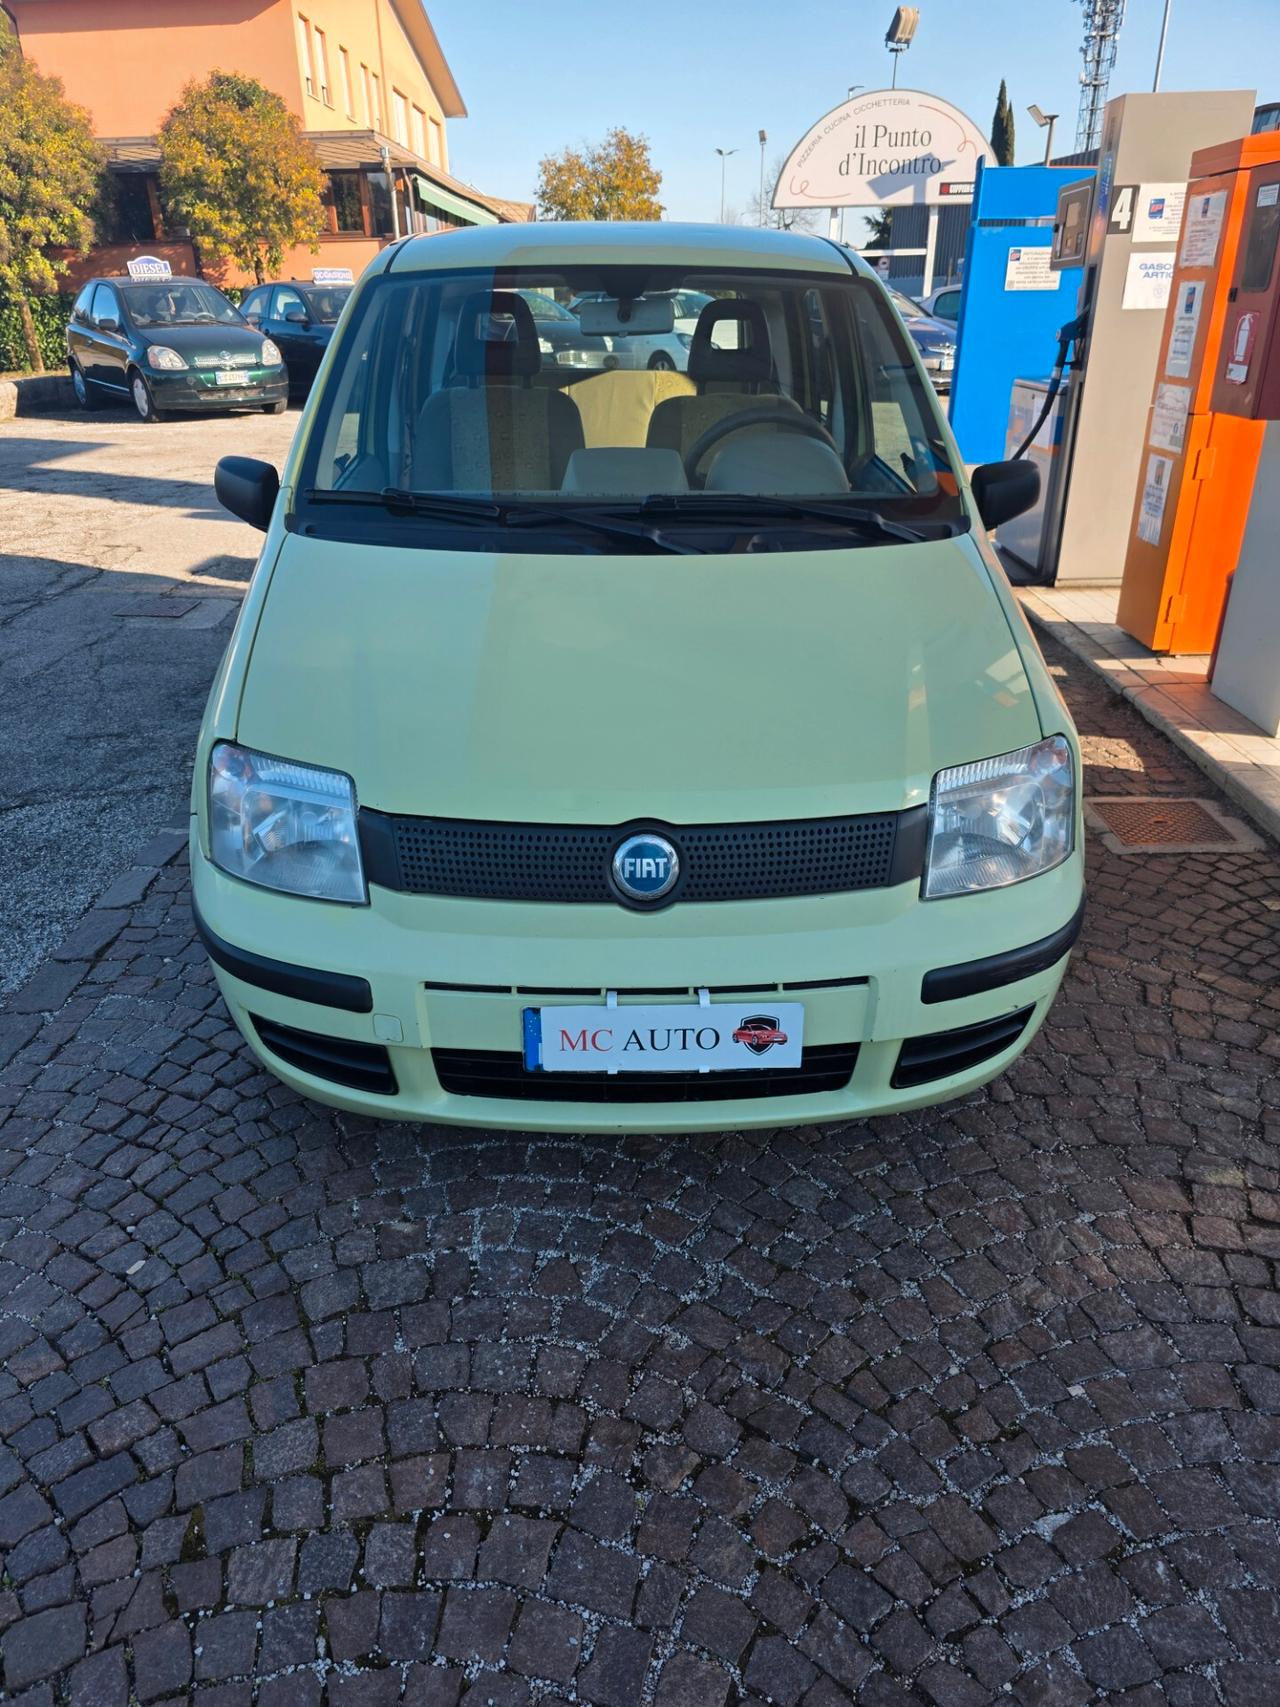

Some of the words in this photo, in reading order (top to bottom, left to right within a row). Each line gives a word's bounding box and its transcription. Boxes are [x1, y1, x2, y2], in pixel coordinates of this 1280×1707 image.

[796, 135, 823, 168] PIZZERIA
[823, 112, 852, 134] CUCINA
[853, 98, 911, 115] CICCHETTERIA
[854, 125, 866, 148] il
[872, 124, 932, 148] Punto
[1111, 187, 1134, 230] 4
[132, 263, 169, 274] DIESEL
[624, 858, 668, 879] FIAT
[559, 1028, 613, 1052] MC
[622, 1027, 720, 1051] AUTO
